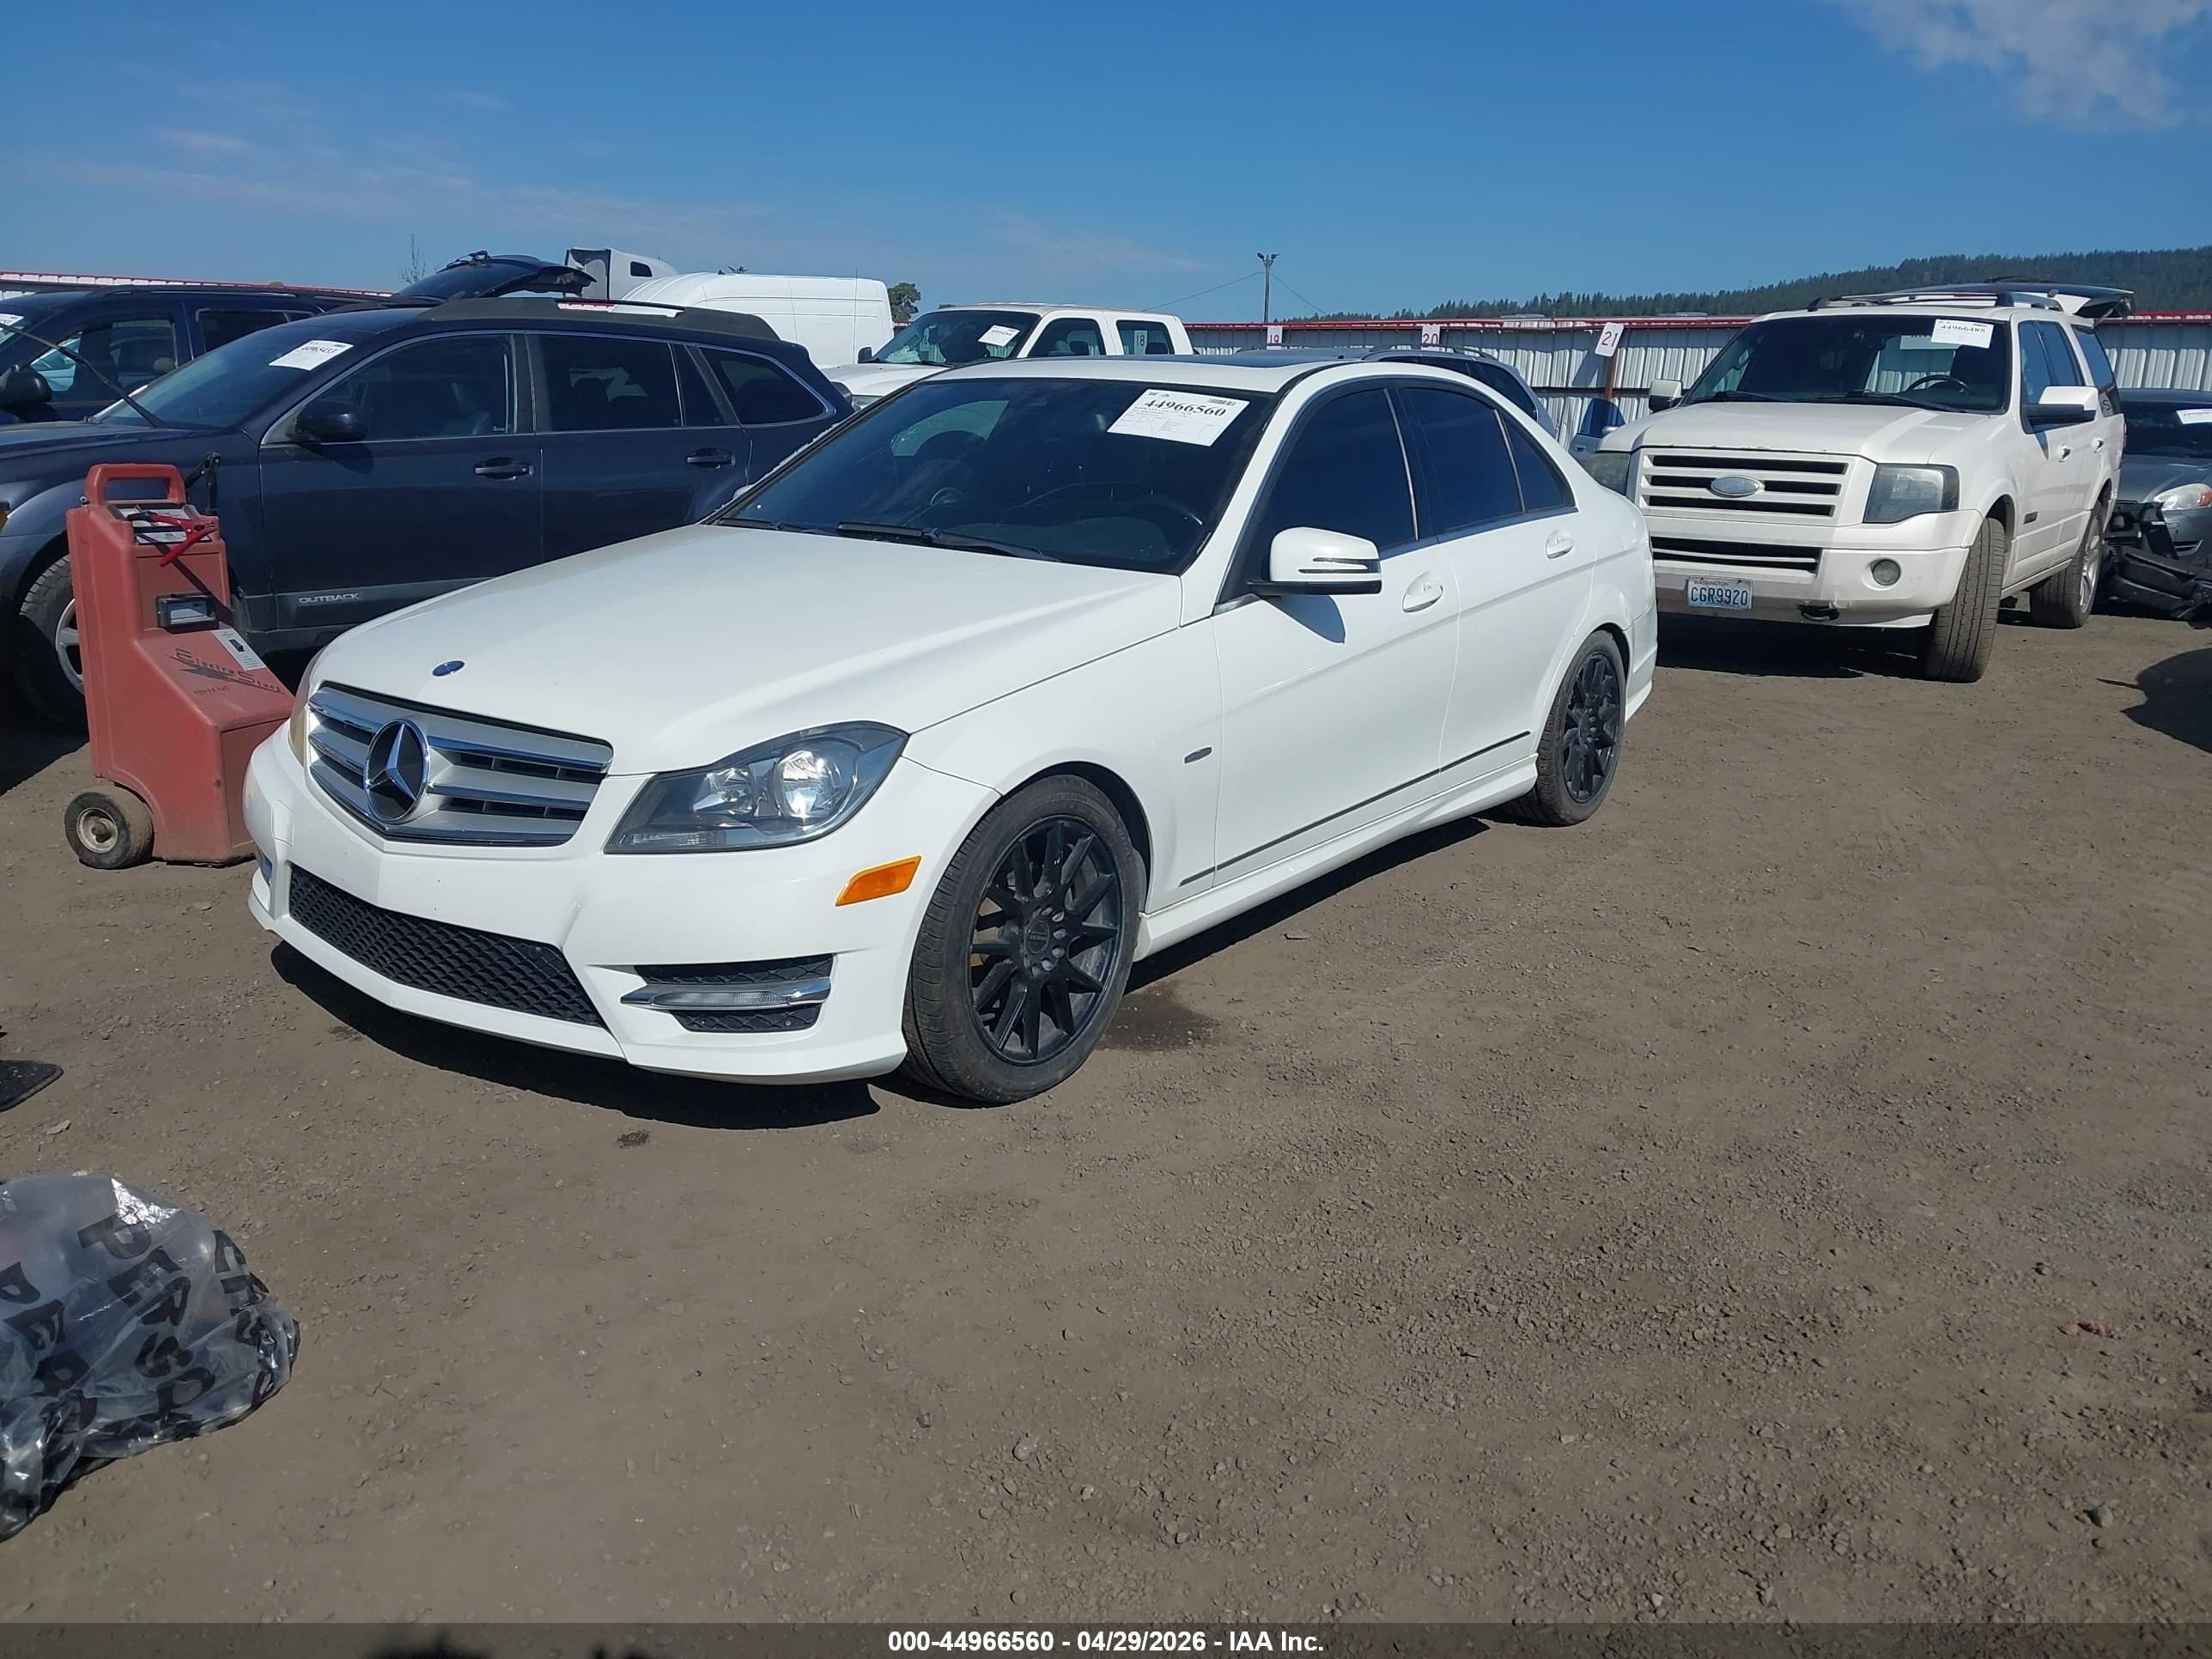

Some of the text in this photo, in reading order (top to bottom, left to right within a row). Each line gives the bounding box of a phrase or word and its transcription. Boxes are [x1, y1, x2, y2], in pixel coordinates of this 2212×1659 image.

[1136, 335, 1146, 346] 18
[1269, 334, 1279, 343] 19
[1423, 333, 1438, 345] 20
[1601, 331, 1618, 347] 21
[1144, 398, 1227, 416] 44966560
[298, 592, 360, 604] OUTBACK
[1691, 586, 1748, 605] CGR9920
